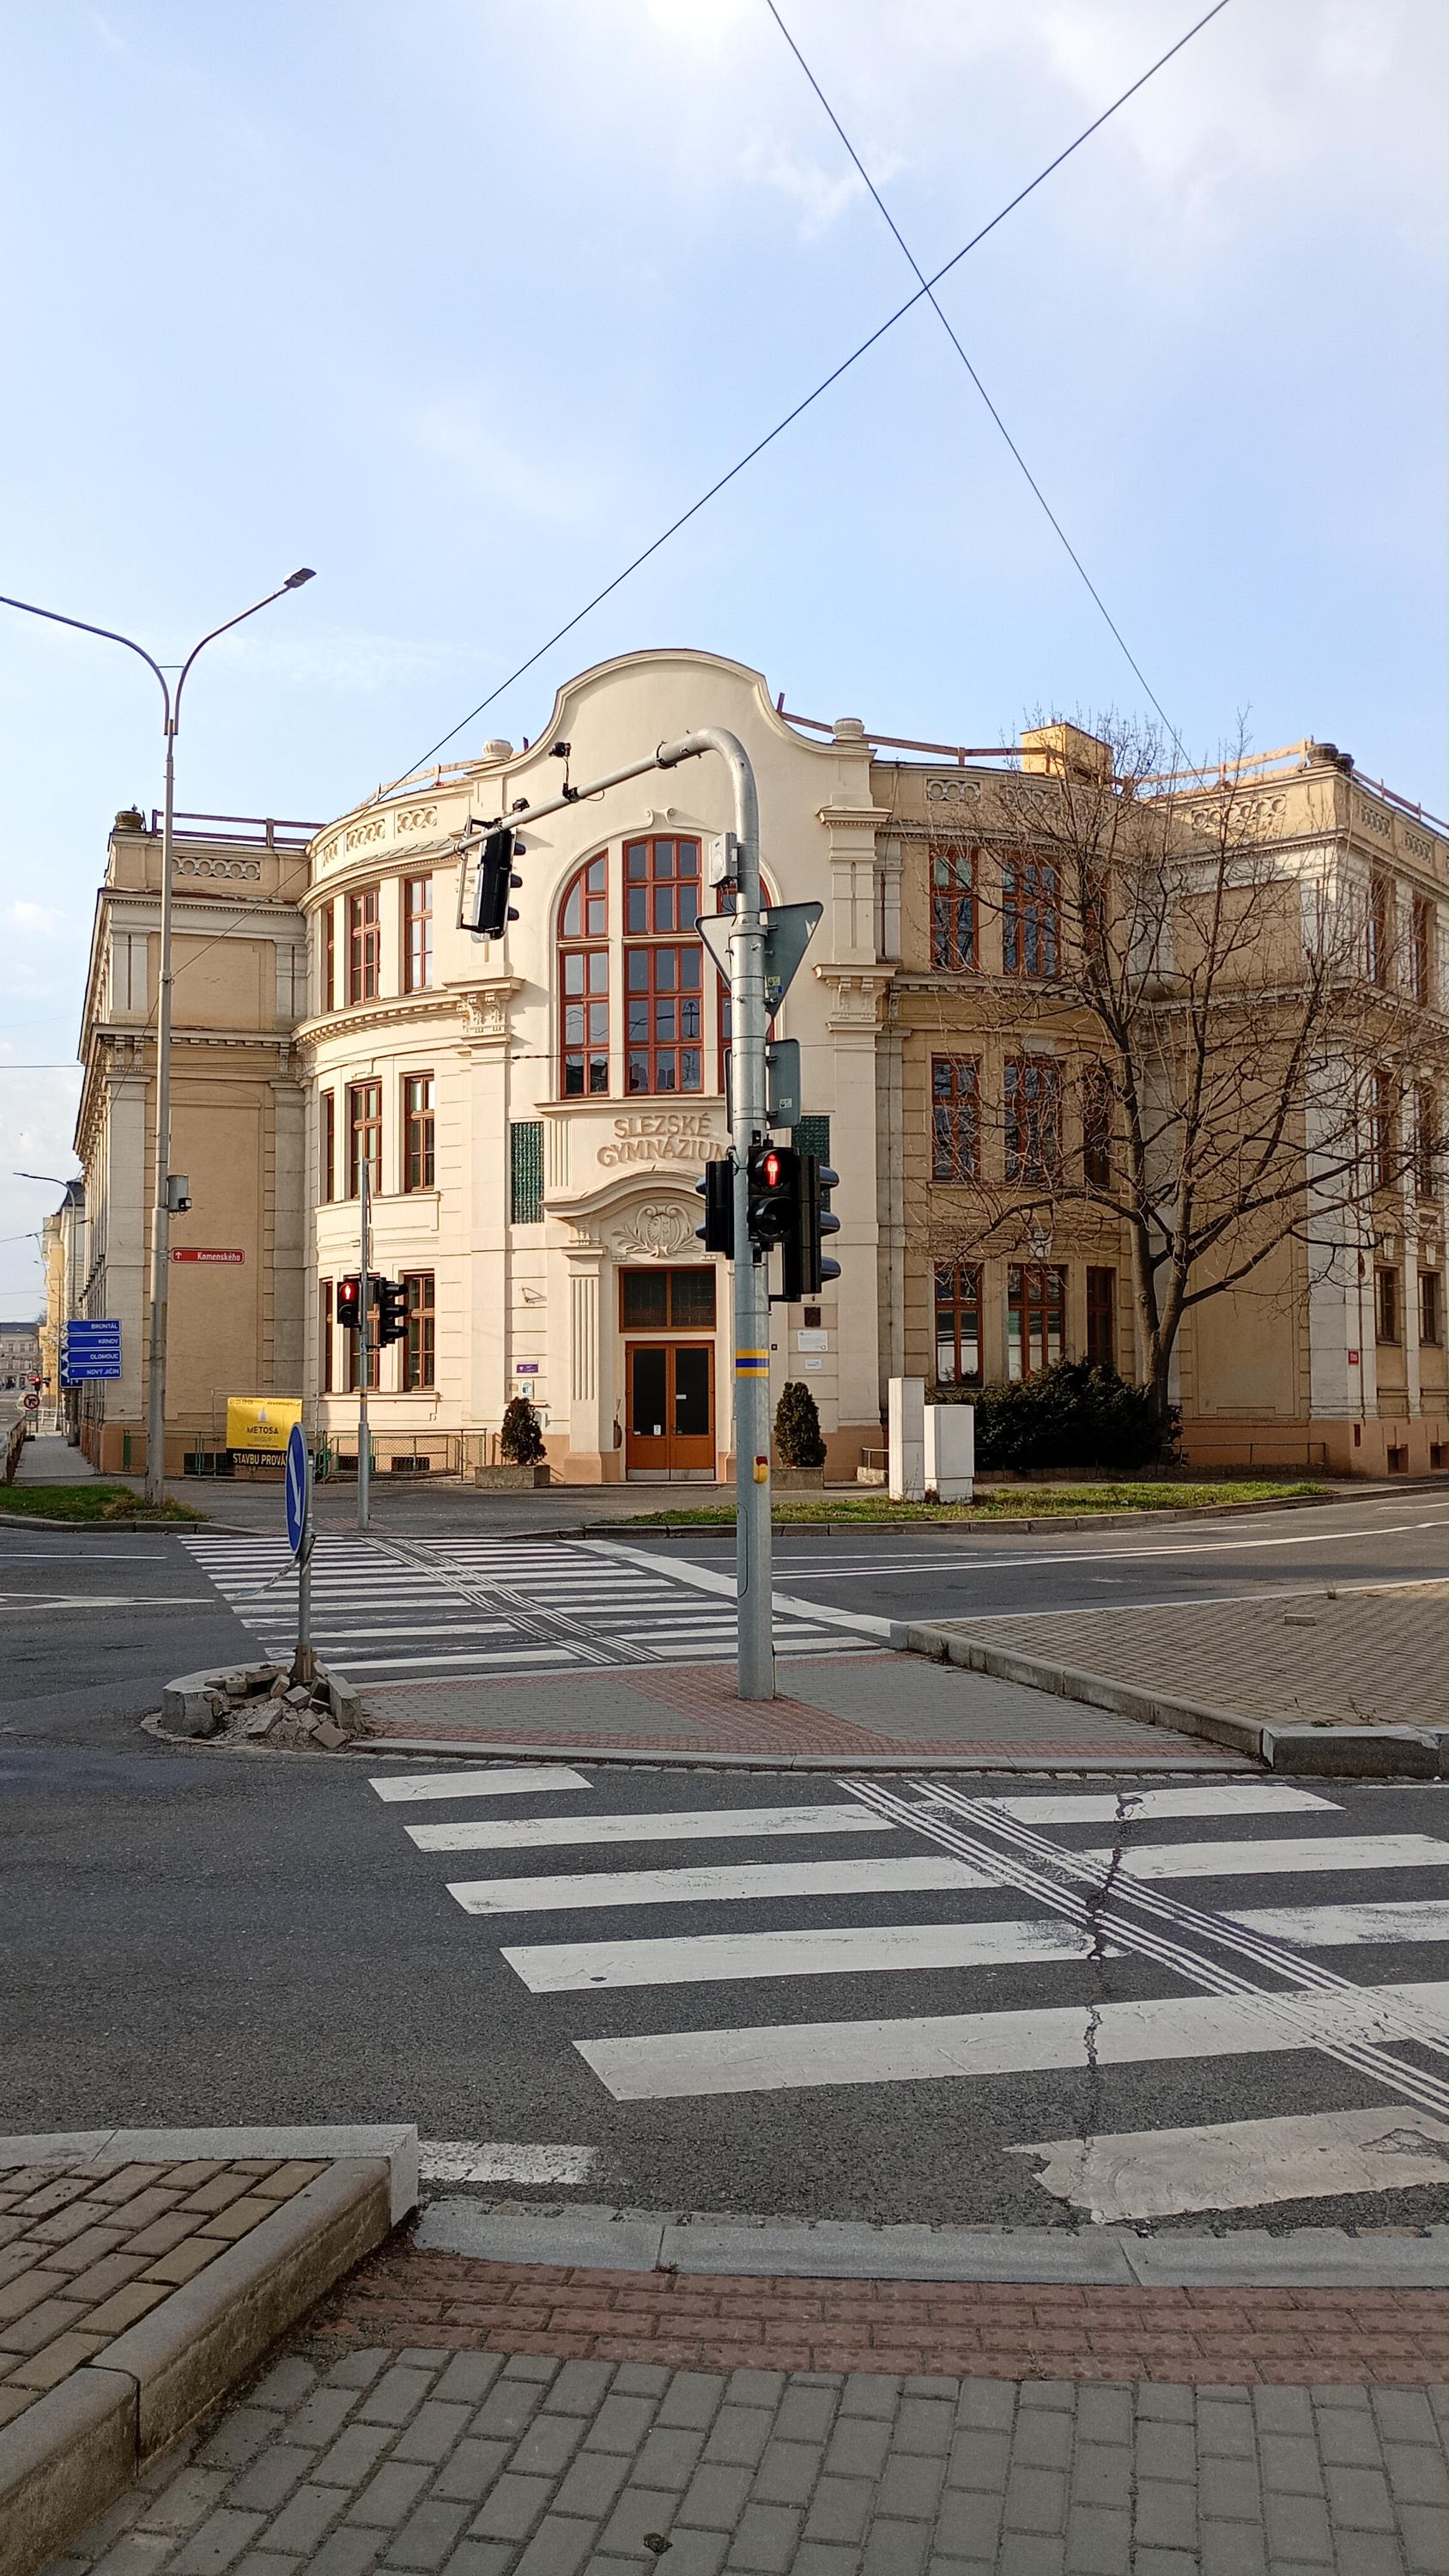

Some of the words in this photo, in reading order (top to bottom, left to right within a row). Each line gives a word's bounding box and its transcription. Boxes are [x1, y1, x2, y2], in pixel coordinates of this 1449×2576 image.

[614, 1113, 712, 1139] SLEZSKÉ
[197, 1251, 240, 1261] Komenského
[246, 1425, 279, 1435] METOSA
[233, 1453, 260, 1465] STAVBU
[261, 1453, 287, 1467] PROVÁ
